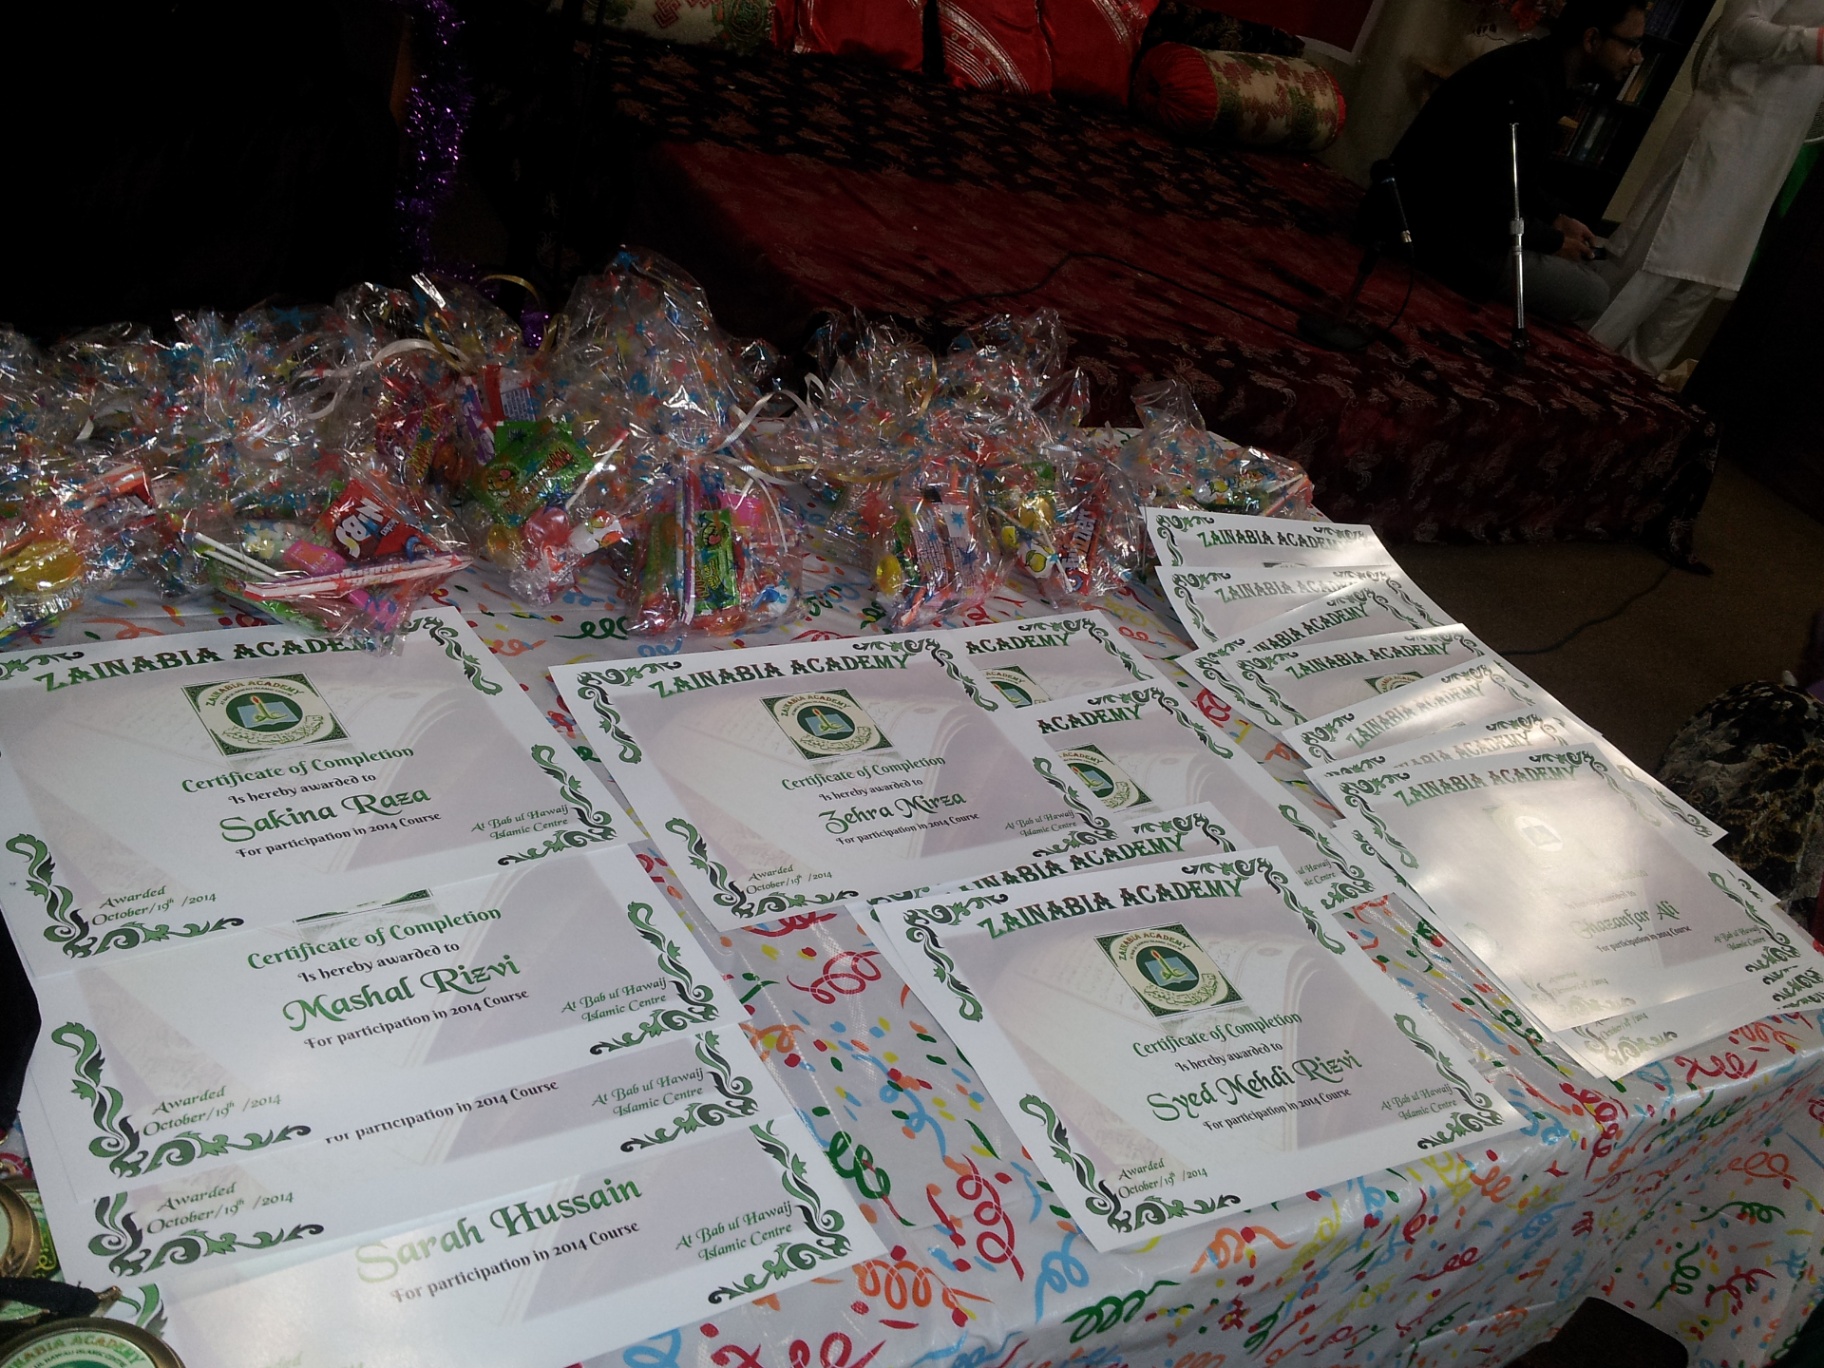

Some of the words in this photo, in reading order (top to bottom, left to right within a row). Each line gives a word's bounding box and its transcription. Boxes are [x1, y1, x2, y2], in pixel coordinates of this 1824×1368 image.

[1197, 529, 1273, 548] ZAINABIA
[1215, 579, 1298, 603] ZAINABIA
[1302, 604, 1369, 635] ACADEMY
[965, 633, 1071, 654] ACADEMY
[32, 647, 225, 692] ZAINABIA
[649, 662, 785, 699] ZAINABIA
[790, 654, 911, 670] ACADEMY
[1286, 651, 1368, 680] ZAINABIA
[1370, 644, 1450, 663] ACADEMY
[206, 680, 245, 706] ZAINABIA
[248, 680, 304, 696] ACADEMY
[985, 672, 1025, 684] ACADEMY
[781, 696, 806, 716] ZAINABIA
[808, 695, 851, 708] ACADEMY
[1036, 704, 1143, 734] ACADEMY
[1346, 704, 1414, 749] ZAINABIA
[1416, 683, 1483, 713] ACADEMY
[1062, 752, 1104, 765] ACADEMY
[1453, 731, 1532, 759] ACADEMY
[181, 768, 285, 793] Certificate
[288, 761, 308, 776] of
[311, 747, 414, 772] Completion
[782, 770, 855, 791] Certificate
[857, 766, 871, 779] of
[872, 757, 945, 775] Completion
[228, 795, 245, 805] Is
[248, 786, 297, 803] hereby
[300, 778, 359, 793] awarded
[362, 773, 376, 782] to
[834, 787, 868, 800] hereby
[870, 780, 911, 793] awarded
[912, 778, 923, 786] to
[1393, 772, 1488, 807] ZAINABIA
[1489, 767, 1578, 786] ACADEMY
[219, 806, 338, 842] Sakina
[341, 788, 431, 817] Raza
[471, 823, 485, 832] At
[488, 816, 512, 828] Bab
[515, 813, 524, 822] ul
[527, 804, 568, 819] Hawaij
[819, 805, 894, 834] Zehra
[895, 792, 966, 818] Mirza
[1016, 818, 1034, 828] Bab
[1044, 810, 1075, 821] Hawaij
[236, 848, 261, 858] For
[266, 829, 351, 855] participation
[353, 826, 367, 836] in
[369, 822, 398, 834] 2014
[399, 812, 441, 828] Course
[490, 827, 530, 839] Islamic
[533, 819, 568, 831] Centre
[836, 837, 854, 846] For
[857, 824, 917, 843] participation
[928, 819, 948, 828] 2014
[949, 812, 979, 824] Course
[1020, 827, 1049, 837] Islamic
[1051, 821, 1077, 832] Centre
[1069, 838, 1186, 870] ACADEMY
[1306, 859, 1331, 872] Hawaij
[748, 864, 793, 881] Awarded
[1314, 872, 1336, 884] Centre
[99, 885, 166, 908] Awarded
[977, 891, 1114, 939] ZAINABIA
[1120, 877, 1245, 910] ACADEMY
[1569, 909, 1650, 939] Ghazanfar
[1656, 900, 1680, 920] Ali
[248, 937, 361, 970] Certificate
[365, 928, 385, 947] of
[389, 908, 502, 941] Completion
[1119, 934, 1141, 961] ZAINABIA
[1144, 932, 1190, 949] ACADEMY
[1609, 935, 1651, 951] participation
[1671, 925, 1693, 938] Course
[297, 971, 316, 982] Is
[320, 961, 373, 980] hereby
[377, 946, 441, 967] awarded
[444, 941, 460, 952] to
[282, 976, 416, 1031] Mashal
[420, 954, 521, 994] Rizvi
[561, 1002, 576, 1013] At
[579, 994, 606, 1009] Bab
[609, 989, 619, 999] ul
[622, 977, 667, 996] Hawaij
[581, 1006, 625, 1022] Islamic
[629, 994, 666, 1011] Centre
[303, 1036, 332, 1049] For
[337, 1014, 430, 1044] participation
[432, 1010, 448, 1020] in
[450, 1003, 482, 1016] 2014
[483, 990, 529, 1009] Course
[1133, 1031, 1208, 1057] Certificate
[1210, 1025, 1226, 1042] of
[1226, 1013, 1302, 1038] Completion
[1175, 1062, 1189, 1072] Is
[1191, 1053, 1227, 1071] hereby
[1228, 1043, 1271, 1062] awarded
[1272, 1042, 1283, 1051] to
[152, 1086, 226, 1115] Awarded
[592, 1094, 607, 1106] At
[611, 1085, 639, 1101] Bab
[642, 1080, 654, 1091] ul
[657, 1068, 703, 1088] Hawaij
[1147, 1082, 1217, 1121] Syed
[1215, 1065, 1295, 1106] Mehdi
[1292, 1050, 1363, 1084] Rizvi
[1381, 1101, 1392, 1110] At
[1392, 1094, 1411, 1107] Bab
[1412, 1091, 1419, 1101] ul
[1420, 1084, 1453, 1098] Hawaij
[355, 1106, 454, 1140] participation
[457, 1102, 472, 1113] in
[475, 1095, 508, 1109] 2014
[510, 1080, 559, 1101] Course
[613, 1099, 659, 1116] Islamic
[662, 1087, 703, 1104] Centre
[1203, 1121, 1223, 1131] For
[1225, 1103, 1286, 1128] participation
[1287, 1101, 1297, 1111] in
[1299, 1096, 1320, 1107] 2014
[1321, 1087, 1352, 1103] Course
[1398, 1108, 1430, 1120] Islamic
[1430, 1100, 1457, 1113] Centre
[1119, 1158, 1165, 1180] Awarded
[157, 1183, 235, 1212] Awarded
[354, 1217, 485, 1284] Sarah
[489, 1178, 642, 1237] Hussain
[675, 1235, 692, 1250] At
[696, 1223, 725, 1244] Bab
[728, 1218, 740, 1231] ul
[742, 1201, 792, 1226] Hawaij
[698, 1238, 746, 1261] Islamic
[750, 1224, 792, 1246] Centre
[391, 1286, 423, 1303] For
[427, 1251, 531, 1296] participation
[534, 1249, 550, 1261] in
[552, 1238, 588, 1256] 2014
[588, 1221, 640, 1245] Course
